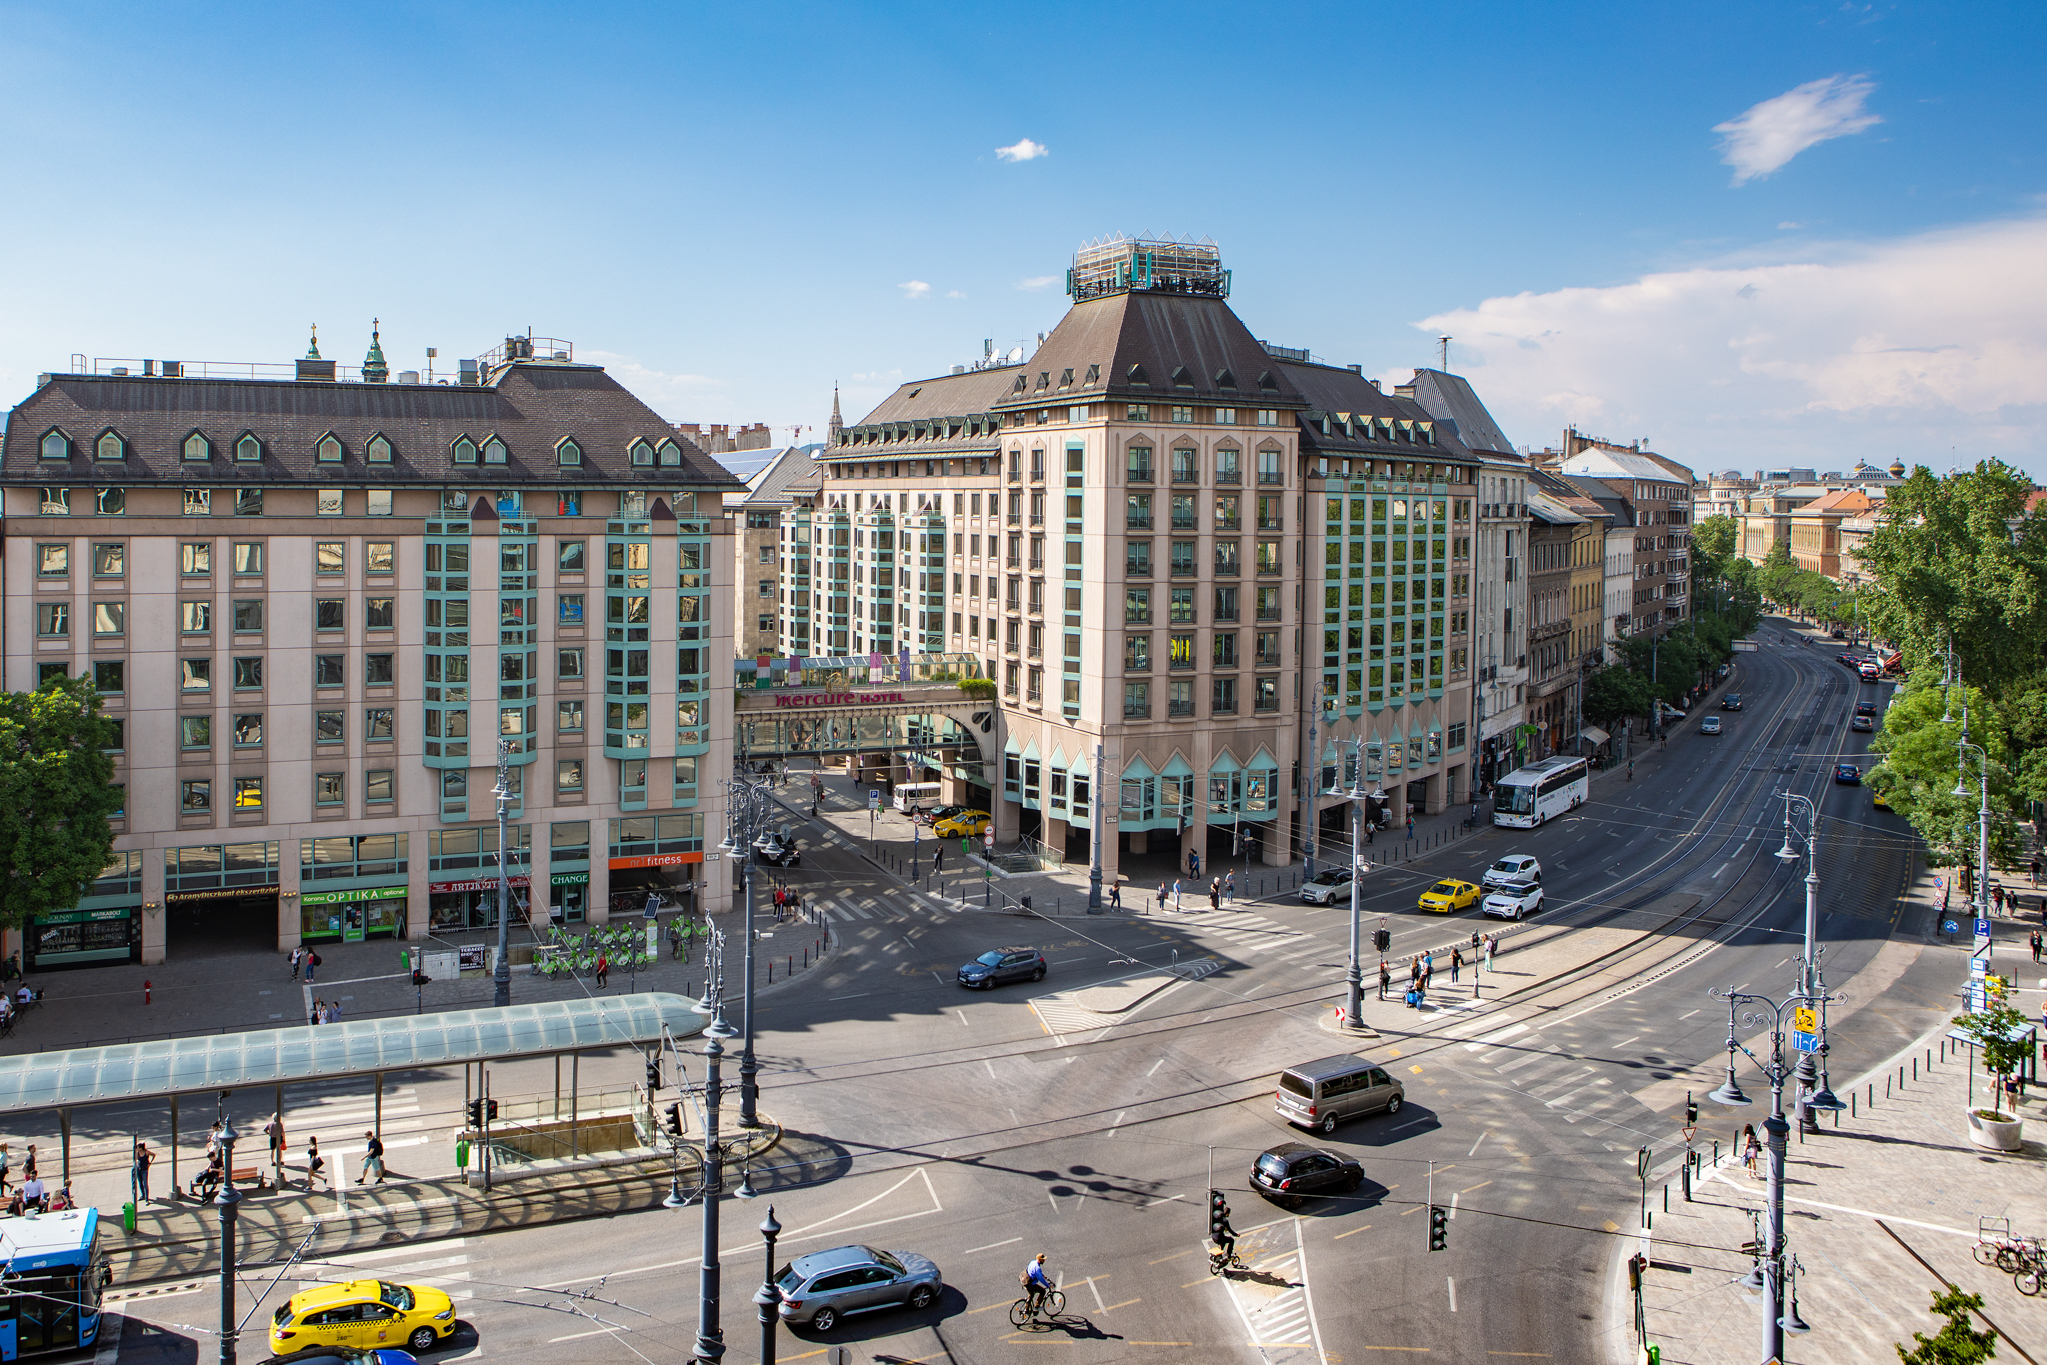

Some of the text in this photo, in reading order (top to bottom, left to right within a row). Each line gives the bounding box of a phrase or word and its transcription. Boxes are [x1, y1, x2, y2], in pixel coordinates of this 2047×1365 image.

[775, 693, 905, 707] mercure HOTEL
[630, 855, 682, 867] nr1 fitness
[551, 874, 588, 885] CHANGE
[326, 890, 379, 903] OPTIKA
[1979, 922, 1987, 931] P
